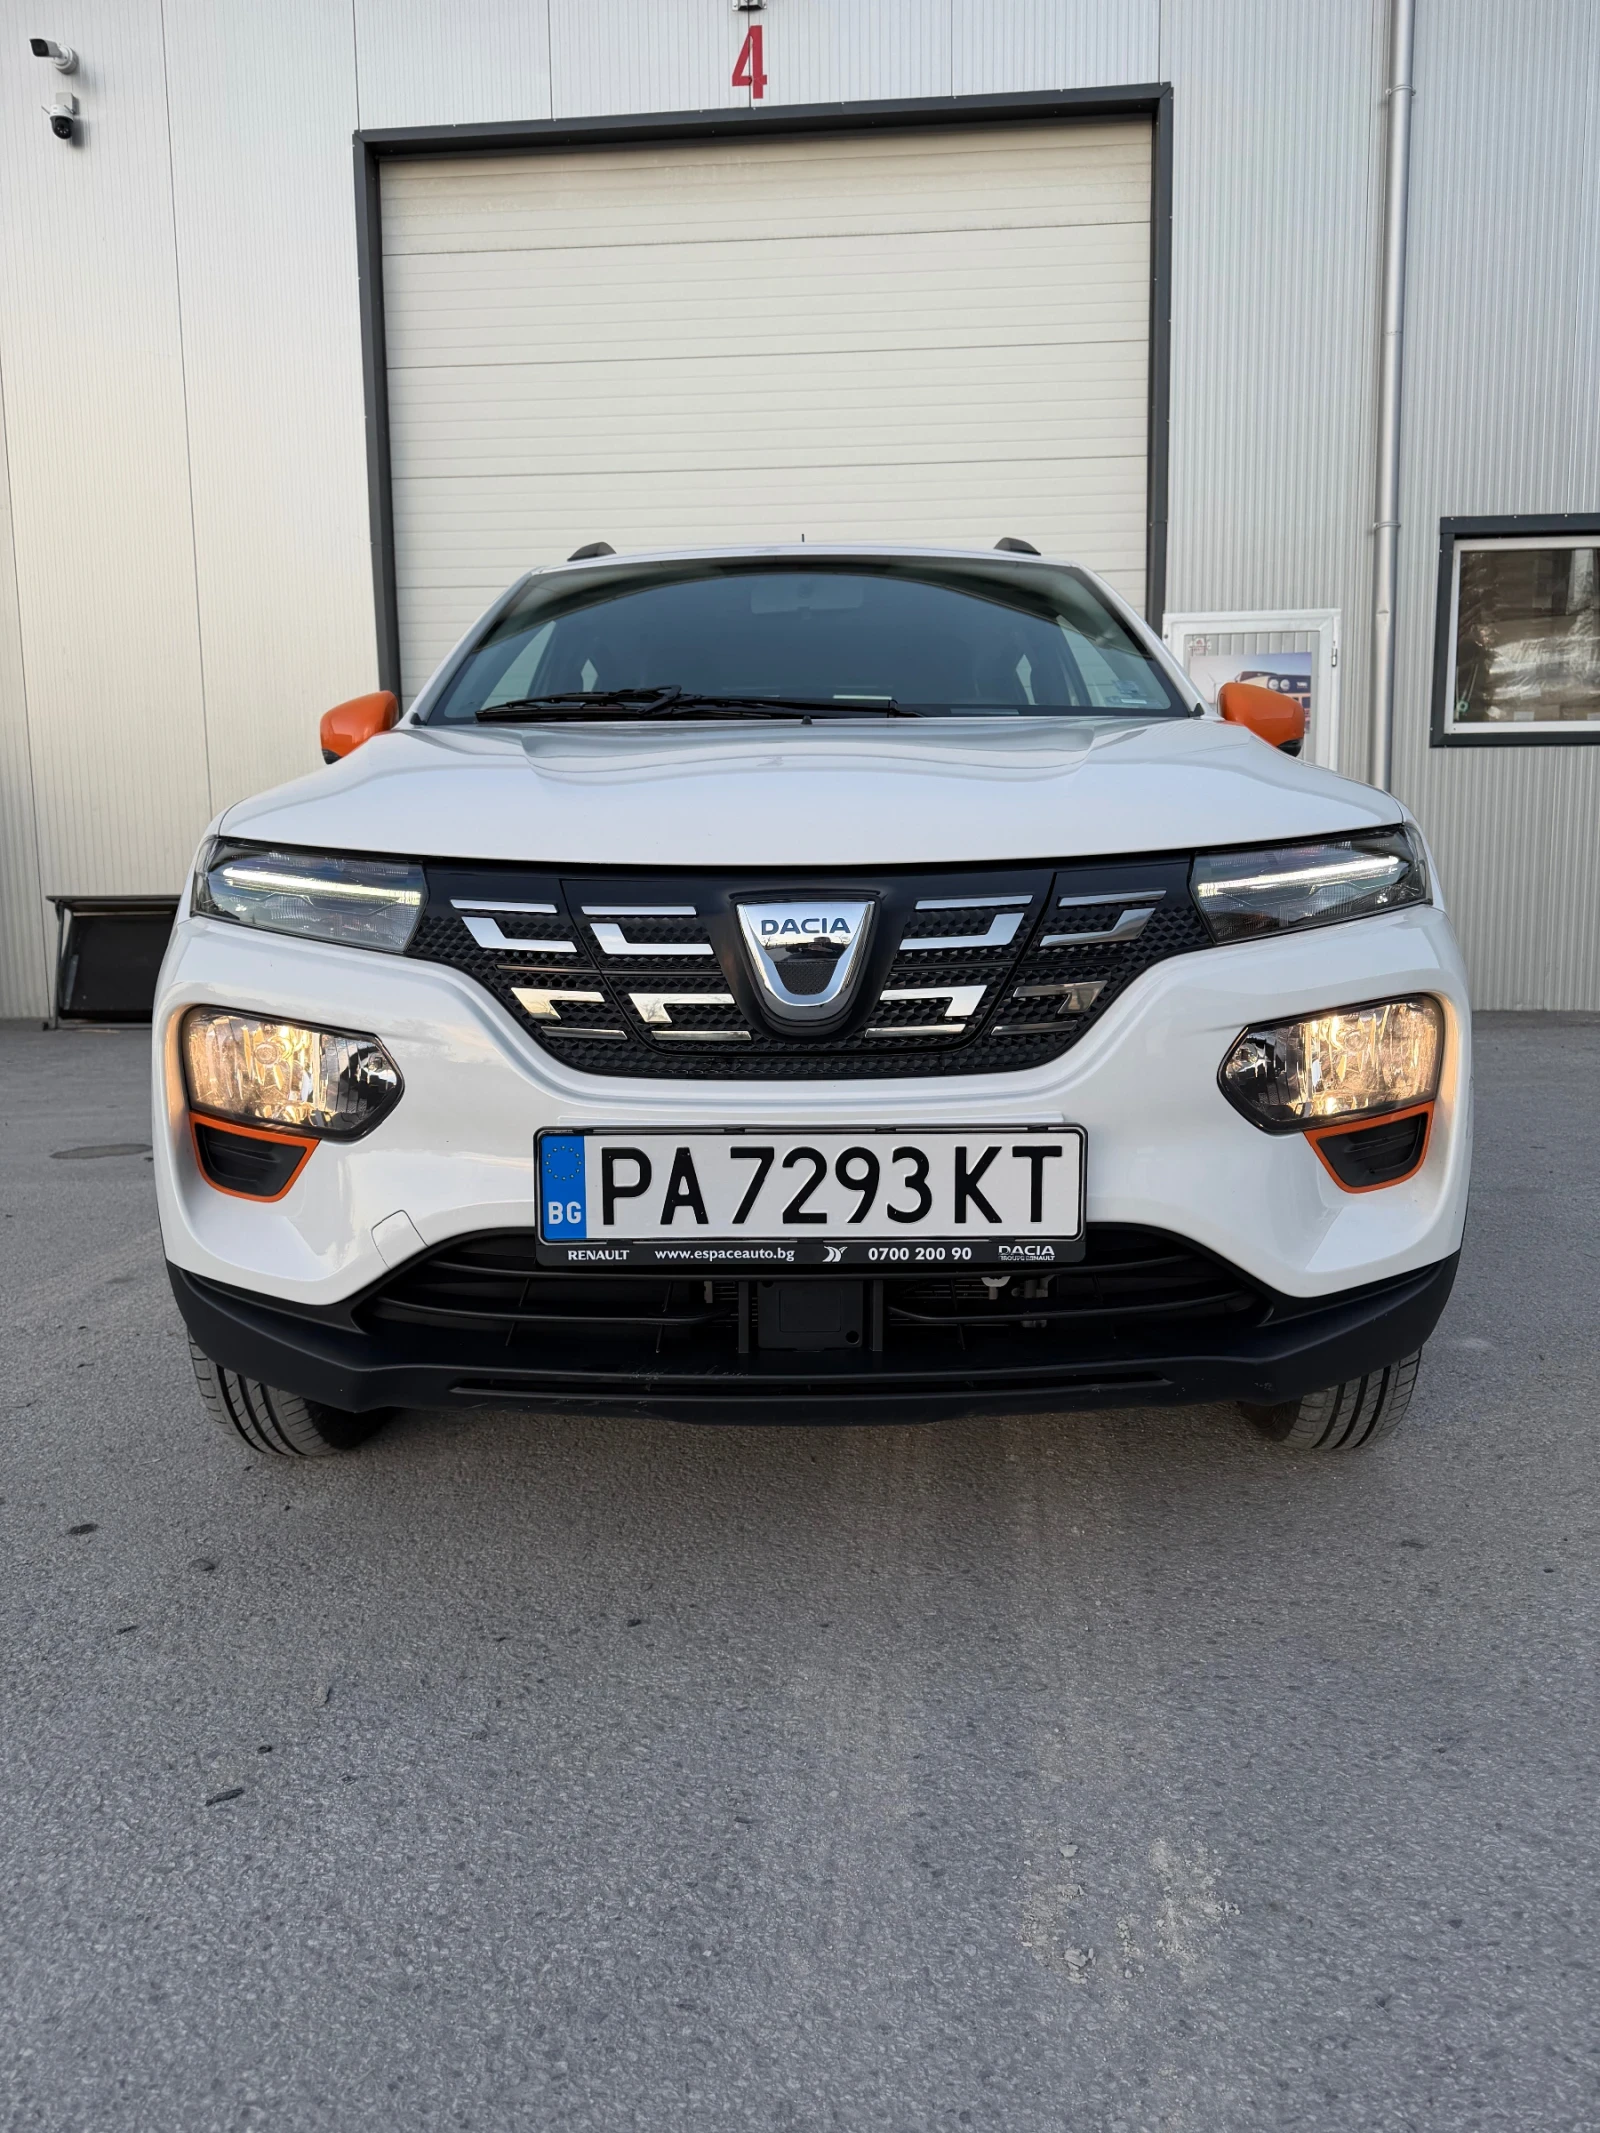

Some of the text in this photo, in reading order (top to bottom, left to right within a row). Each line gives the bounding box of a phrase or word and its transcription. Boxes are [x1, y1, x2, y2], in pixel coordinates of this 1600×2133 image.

[731, 25, 767, 99] 4
[761, 917, 851, 935] DACIA
[601, 1146, 1063, 1225] PA 7293 KT
[548, 1201, 582, 1224] BG
[568, 1250, 630, 1260] RENAULT
[655, 1247, 795, 1262] www.espaceauto.bg
[868, 1247, 972, 1260] 0700 200 90
[998, 1246, 1055, 1256] DACIA
